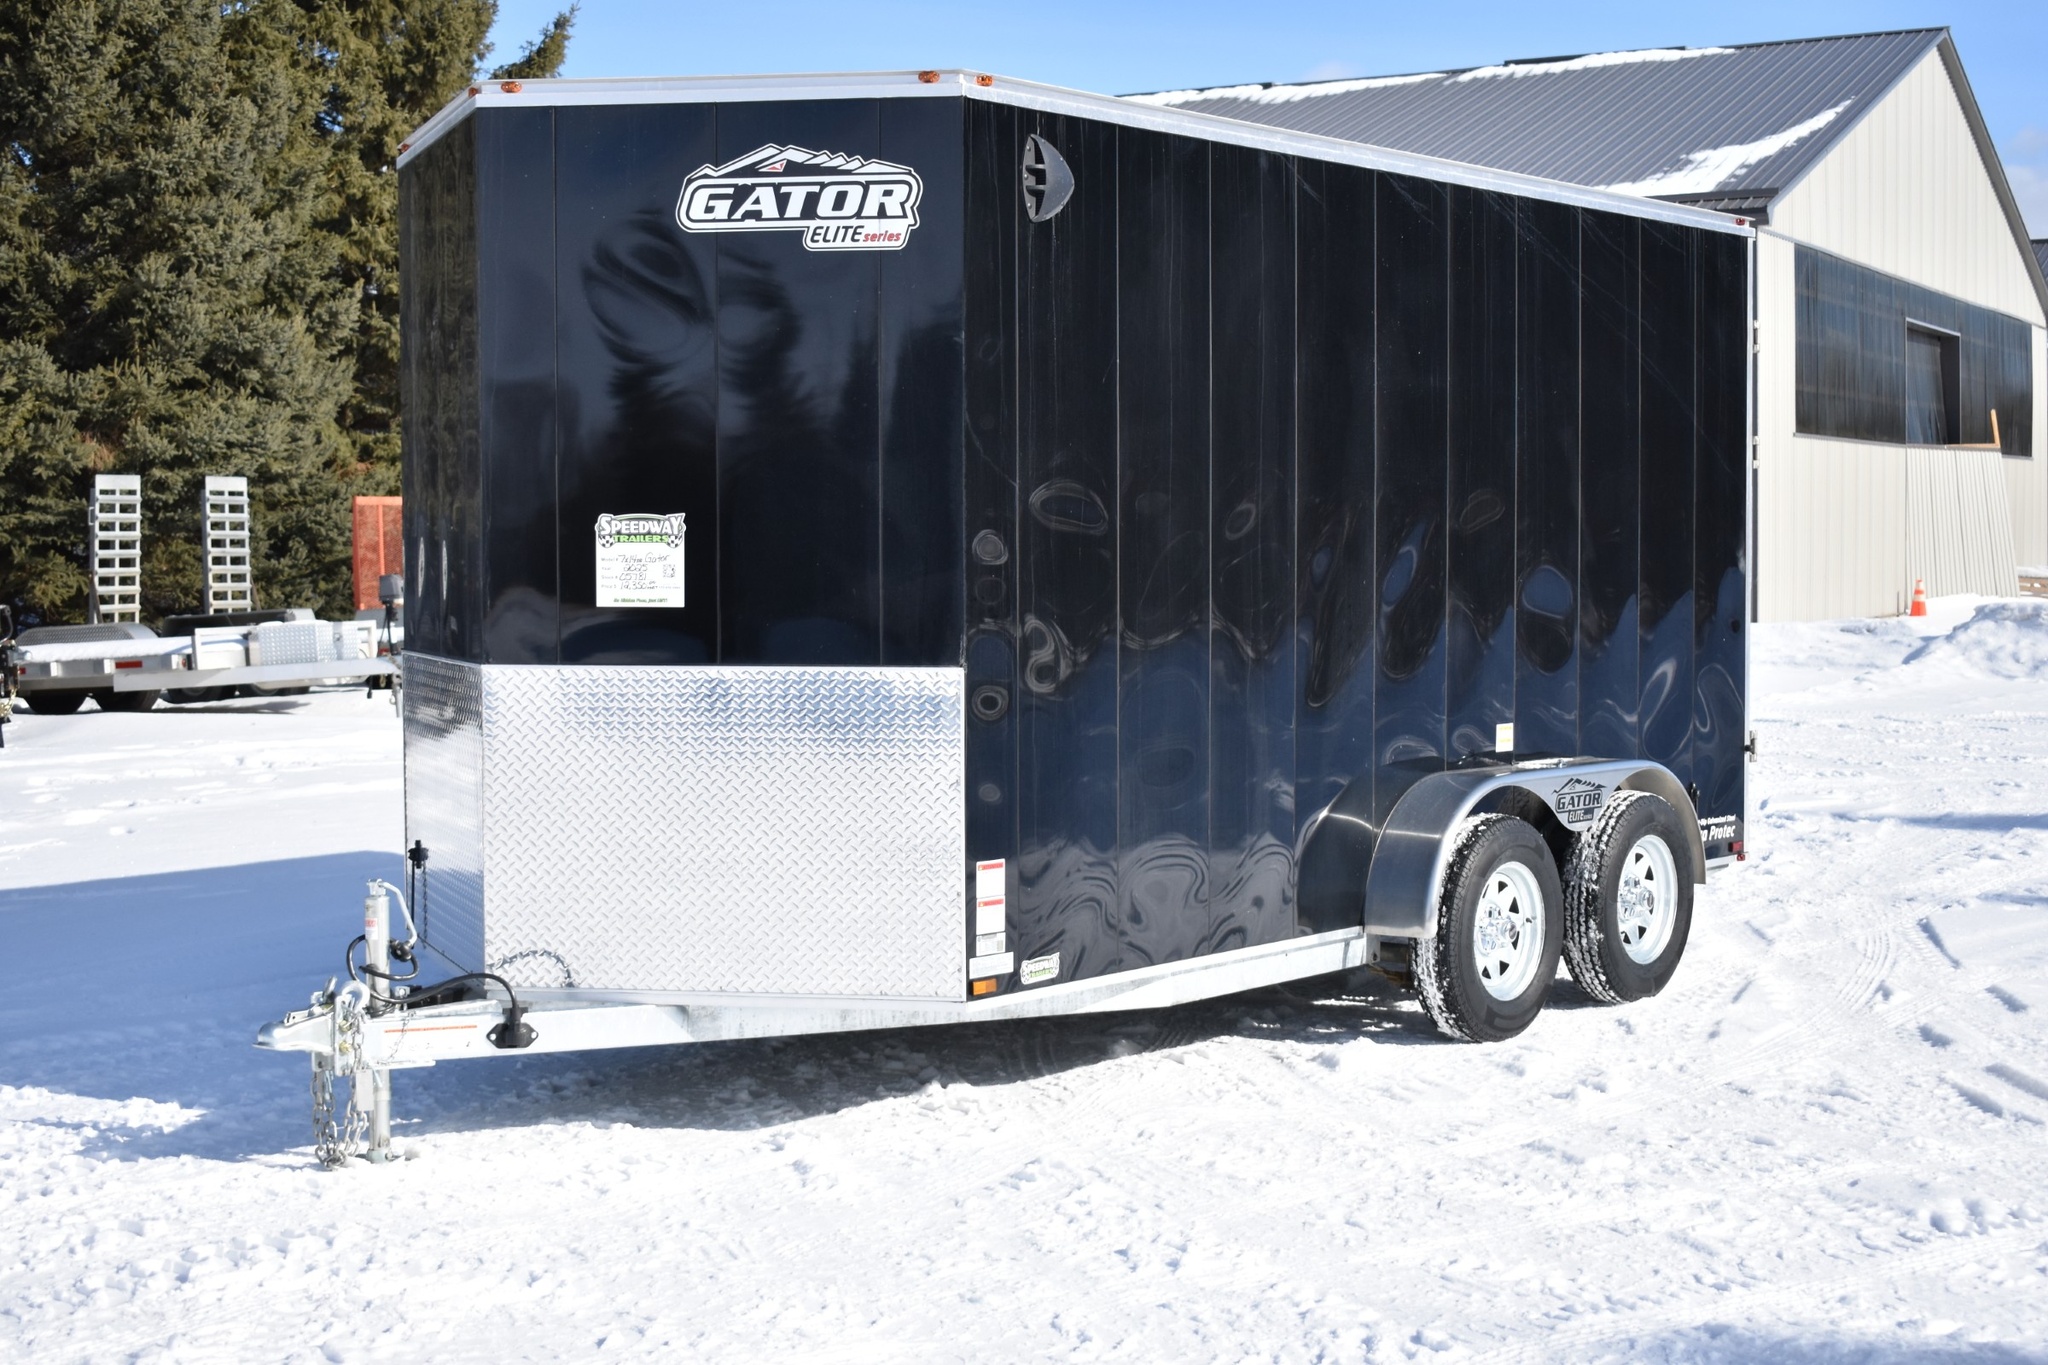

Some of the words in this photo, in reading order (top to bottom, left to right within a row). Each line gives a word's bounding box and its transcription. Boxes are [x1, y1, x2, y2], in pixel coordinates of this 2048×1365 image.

[689, 183, 910, 220] GATOR
[810, 225, 865, 243] ELITE
[863, 230, 902, 243] series
[600, 516, 682, 535] SPEEDWAY
[613, 535, 669, 543] TRAILERS
[1557, 792, 1601, 810] GATOR
[1569, 810, 1585, 822] ELITE
[1700, 829, 1709, 842] a
[1709, 824, 1736, 841] Protec
